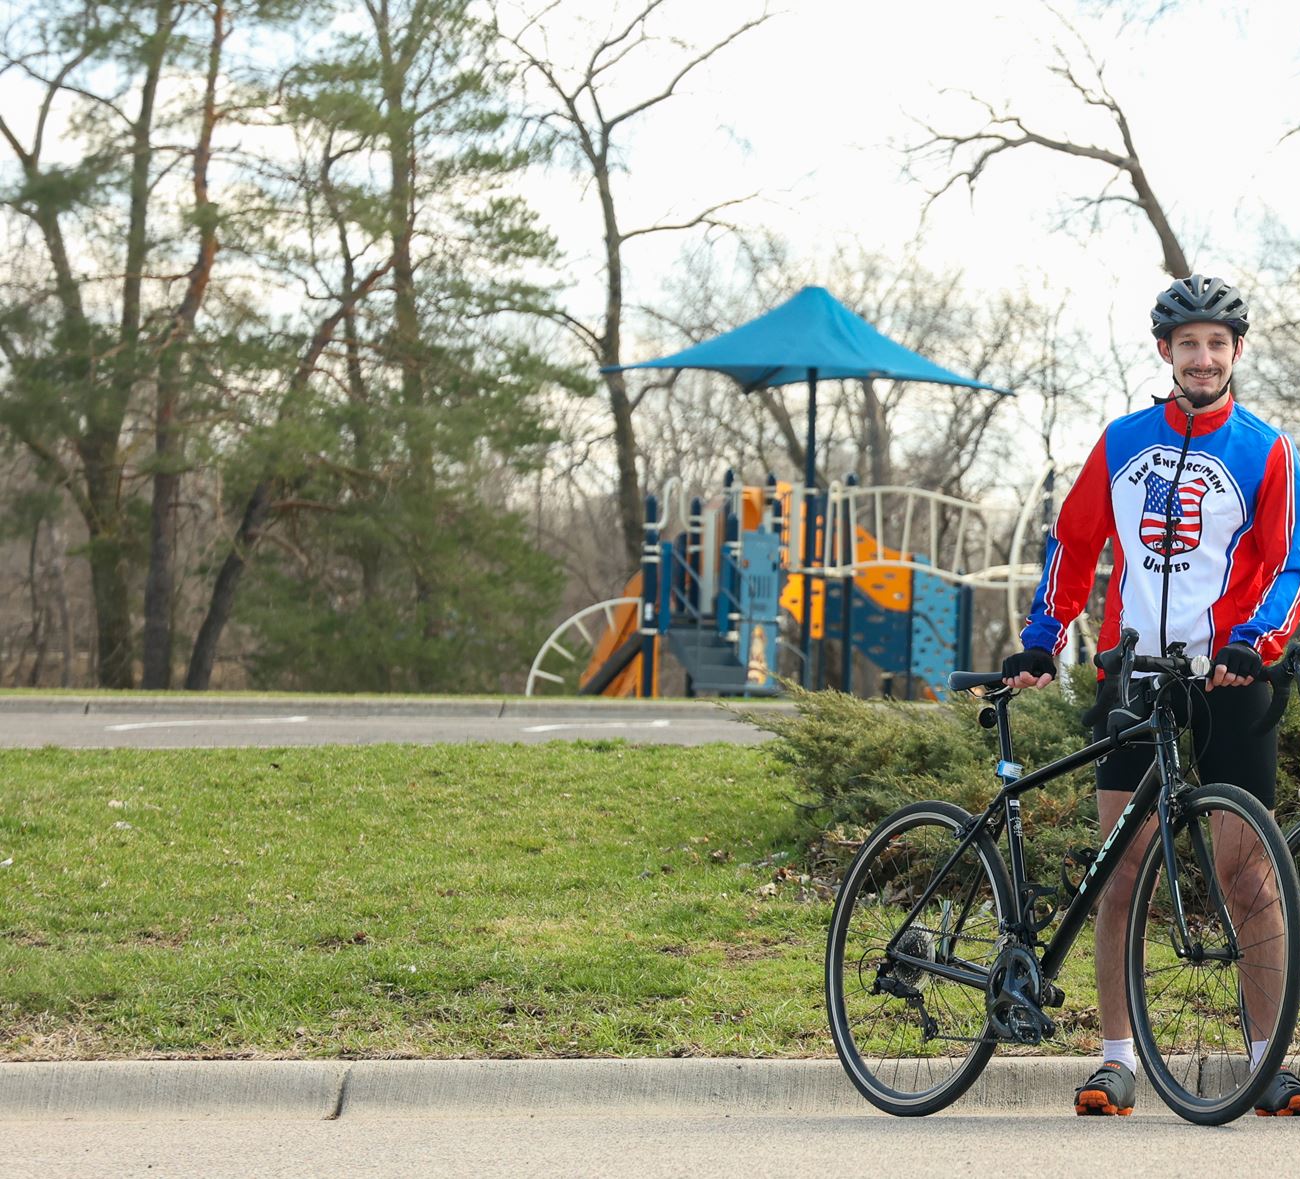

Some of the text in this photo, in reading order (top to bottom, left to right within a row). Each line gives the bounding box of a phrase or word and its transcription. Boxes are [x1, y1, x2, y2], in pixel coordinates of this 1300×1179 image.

[1128, 452, 1226, 494] LAW ENFRCMENT
[1143, 555, 1190, 573] UNTED
